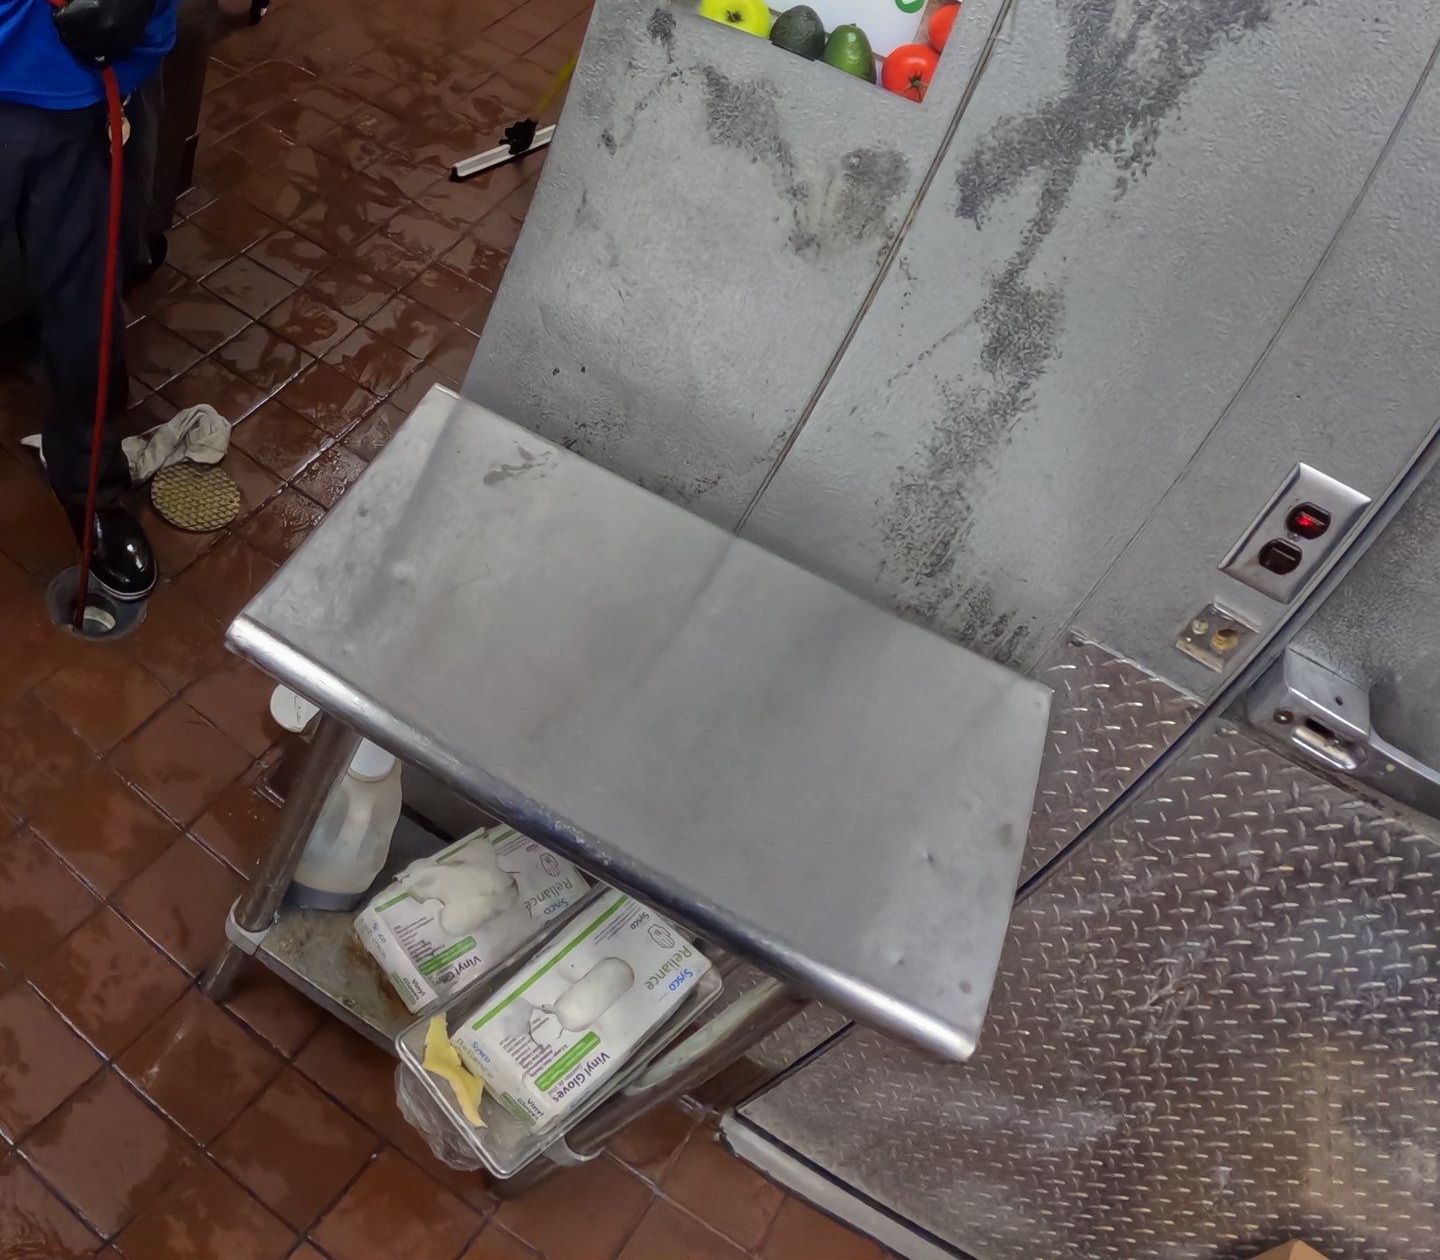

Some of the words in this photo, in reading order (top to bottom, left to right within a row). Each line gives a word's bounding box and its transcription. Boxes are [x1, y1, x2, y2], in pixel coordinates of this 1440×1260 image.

[523, 876, 573, 911] Reliance
[629, 911, 650, 930] Sysco
[455, 955, 482, 976] Vinyl
[644, 944, 693, 990] Reliance
[668, 968, 694, 991] Sysco
[471, 1041, 491, 1063] Sysco
[584, 1051, 611, 1077] Vinyl
[551, 1074, 587, 1103] Gloves
[527, 1098, 545, 1118] Vinyl
